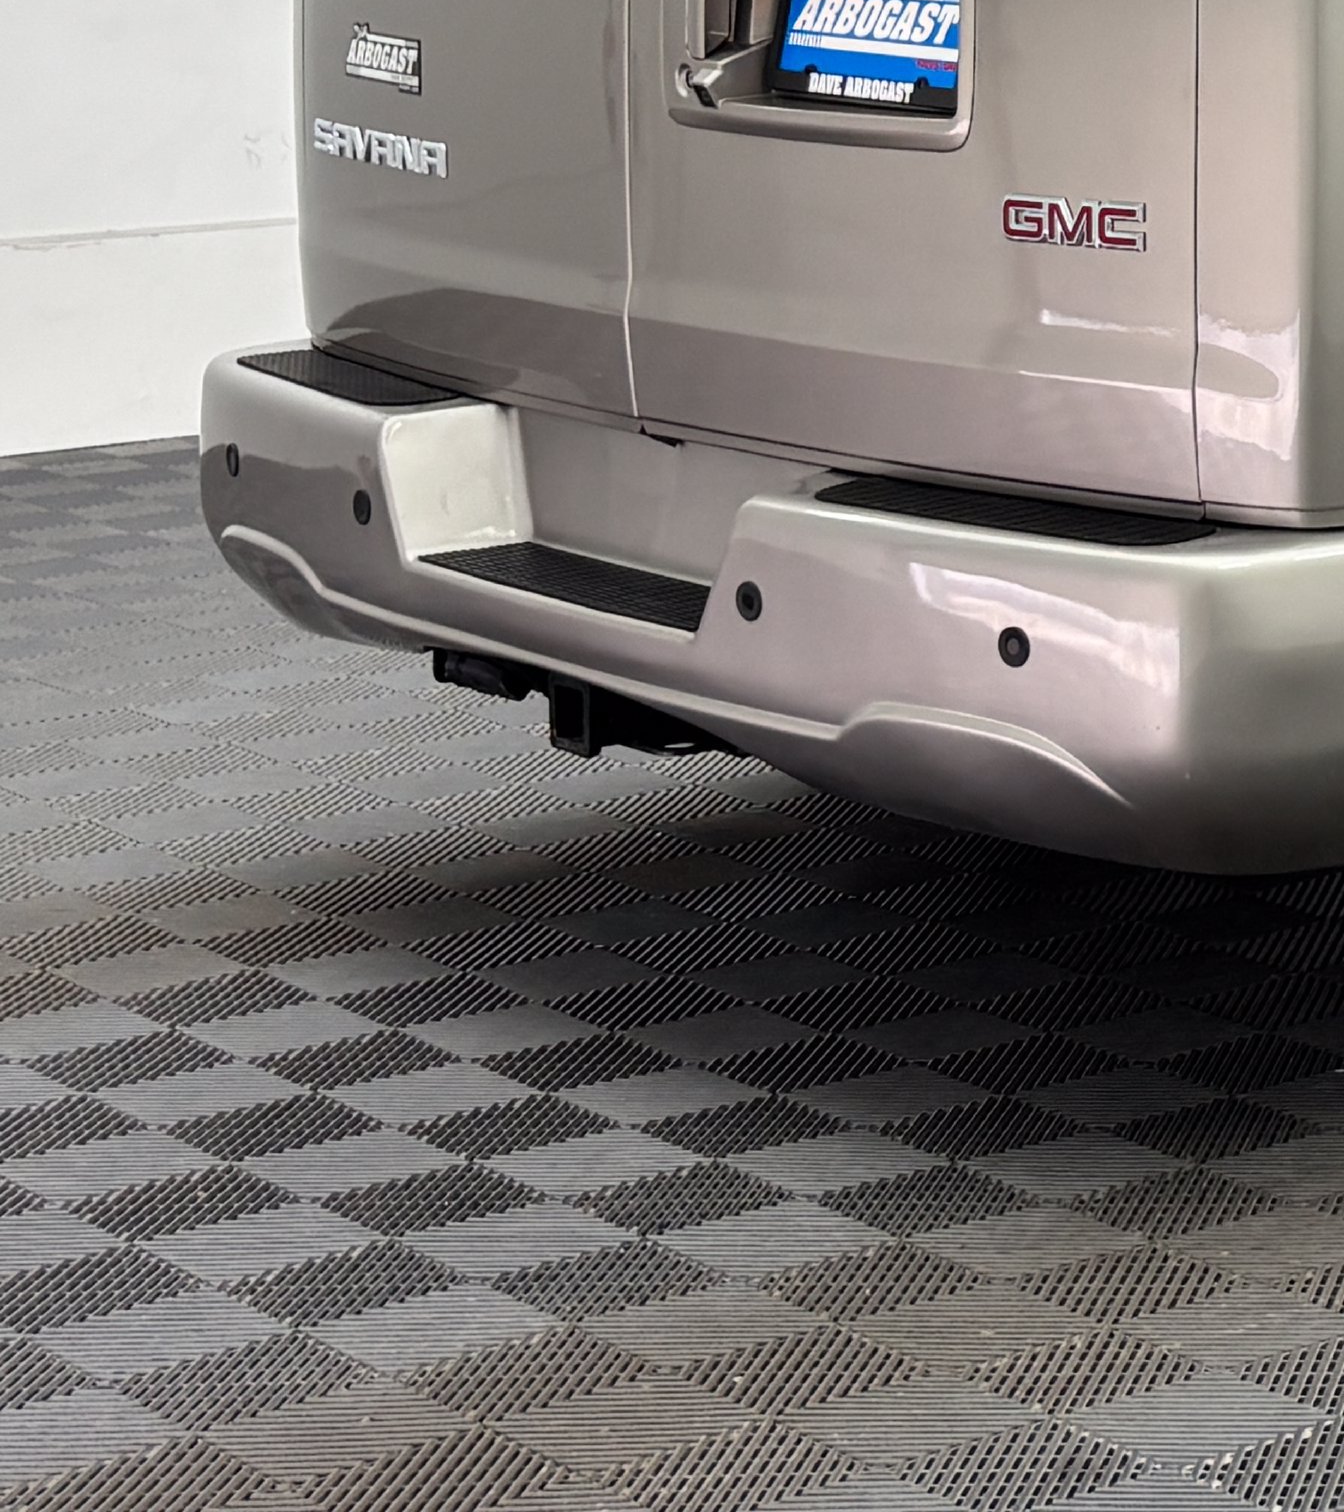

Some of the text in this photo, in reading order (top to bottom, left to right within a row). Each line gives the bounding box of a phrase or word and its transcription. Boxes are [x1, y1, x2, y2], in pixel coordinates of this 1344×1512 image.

[346, 38, 419, 75] ARBOGAST
[808, 71, 915, 104] DAVE ARBOGAST
[313, 117, 449, 179] SAVANA
[1002, 192, 1146, 252] GMC
